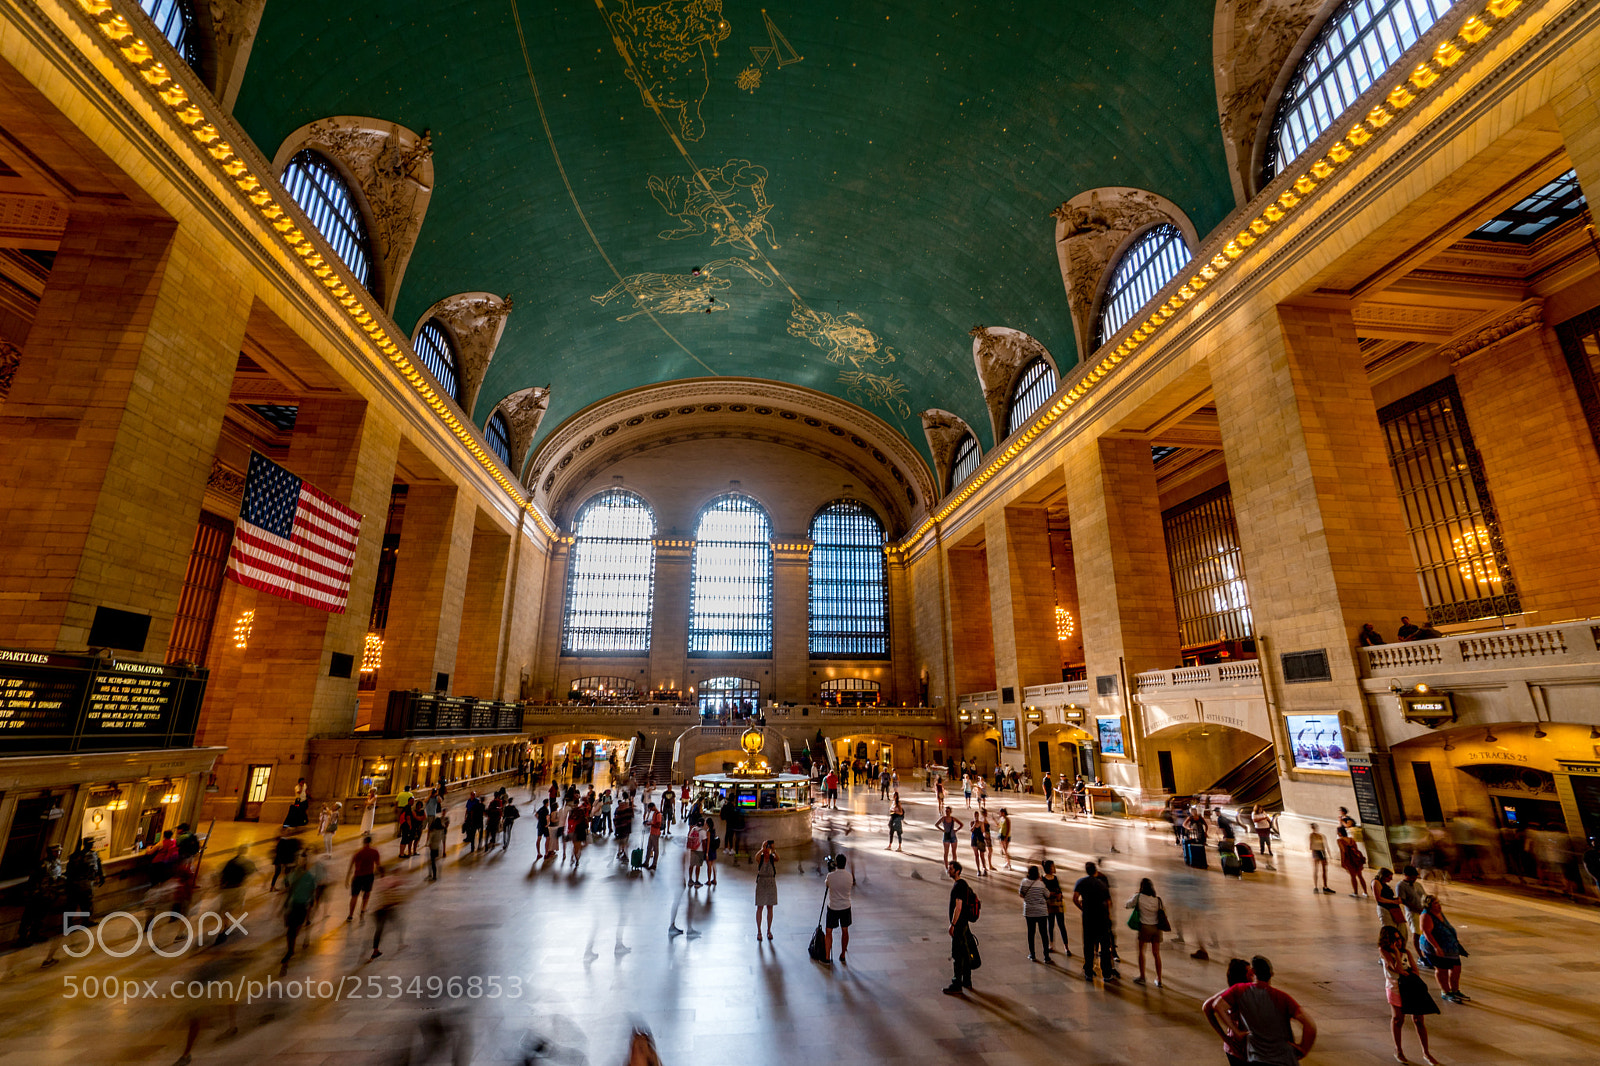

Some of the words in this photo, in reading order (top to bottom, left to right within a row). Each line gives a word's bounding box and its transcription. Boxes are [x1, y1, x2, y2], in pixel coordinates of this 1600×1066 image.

[115, 662, 164, 674] INFORMATION
[7, 679, 23, 687] STOP
[18, 690, 34, 698] STOP
[1221, 716, 1244, 726] STREET
[1478, 752, 1516, 760] TRACKS
[1517, 754, 1528, 762] 25
